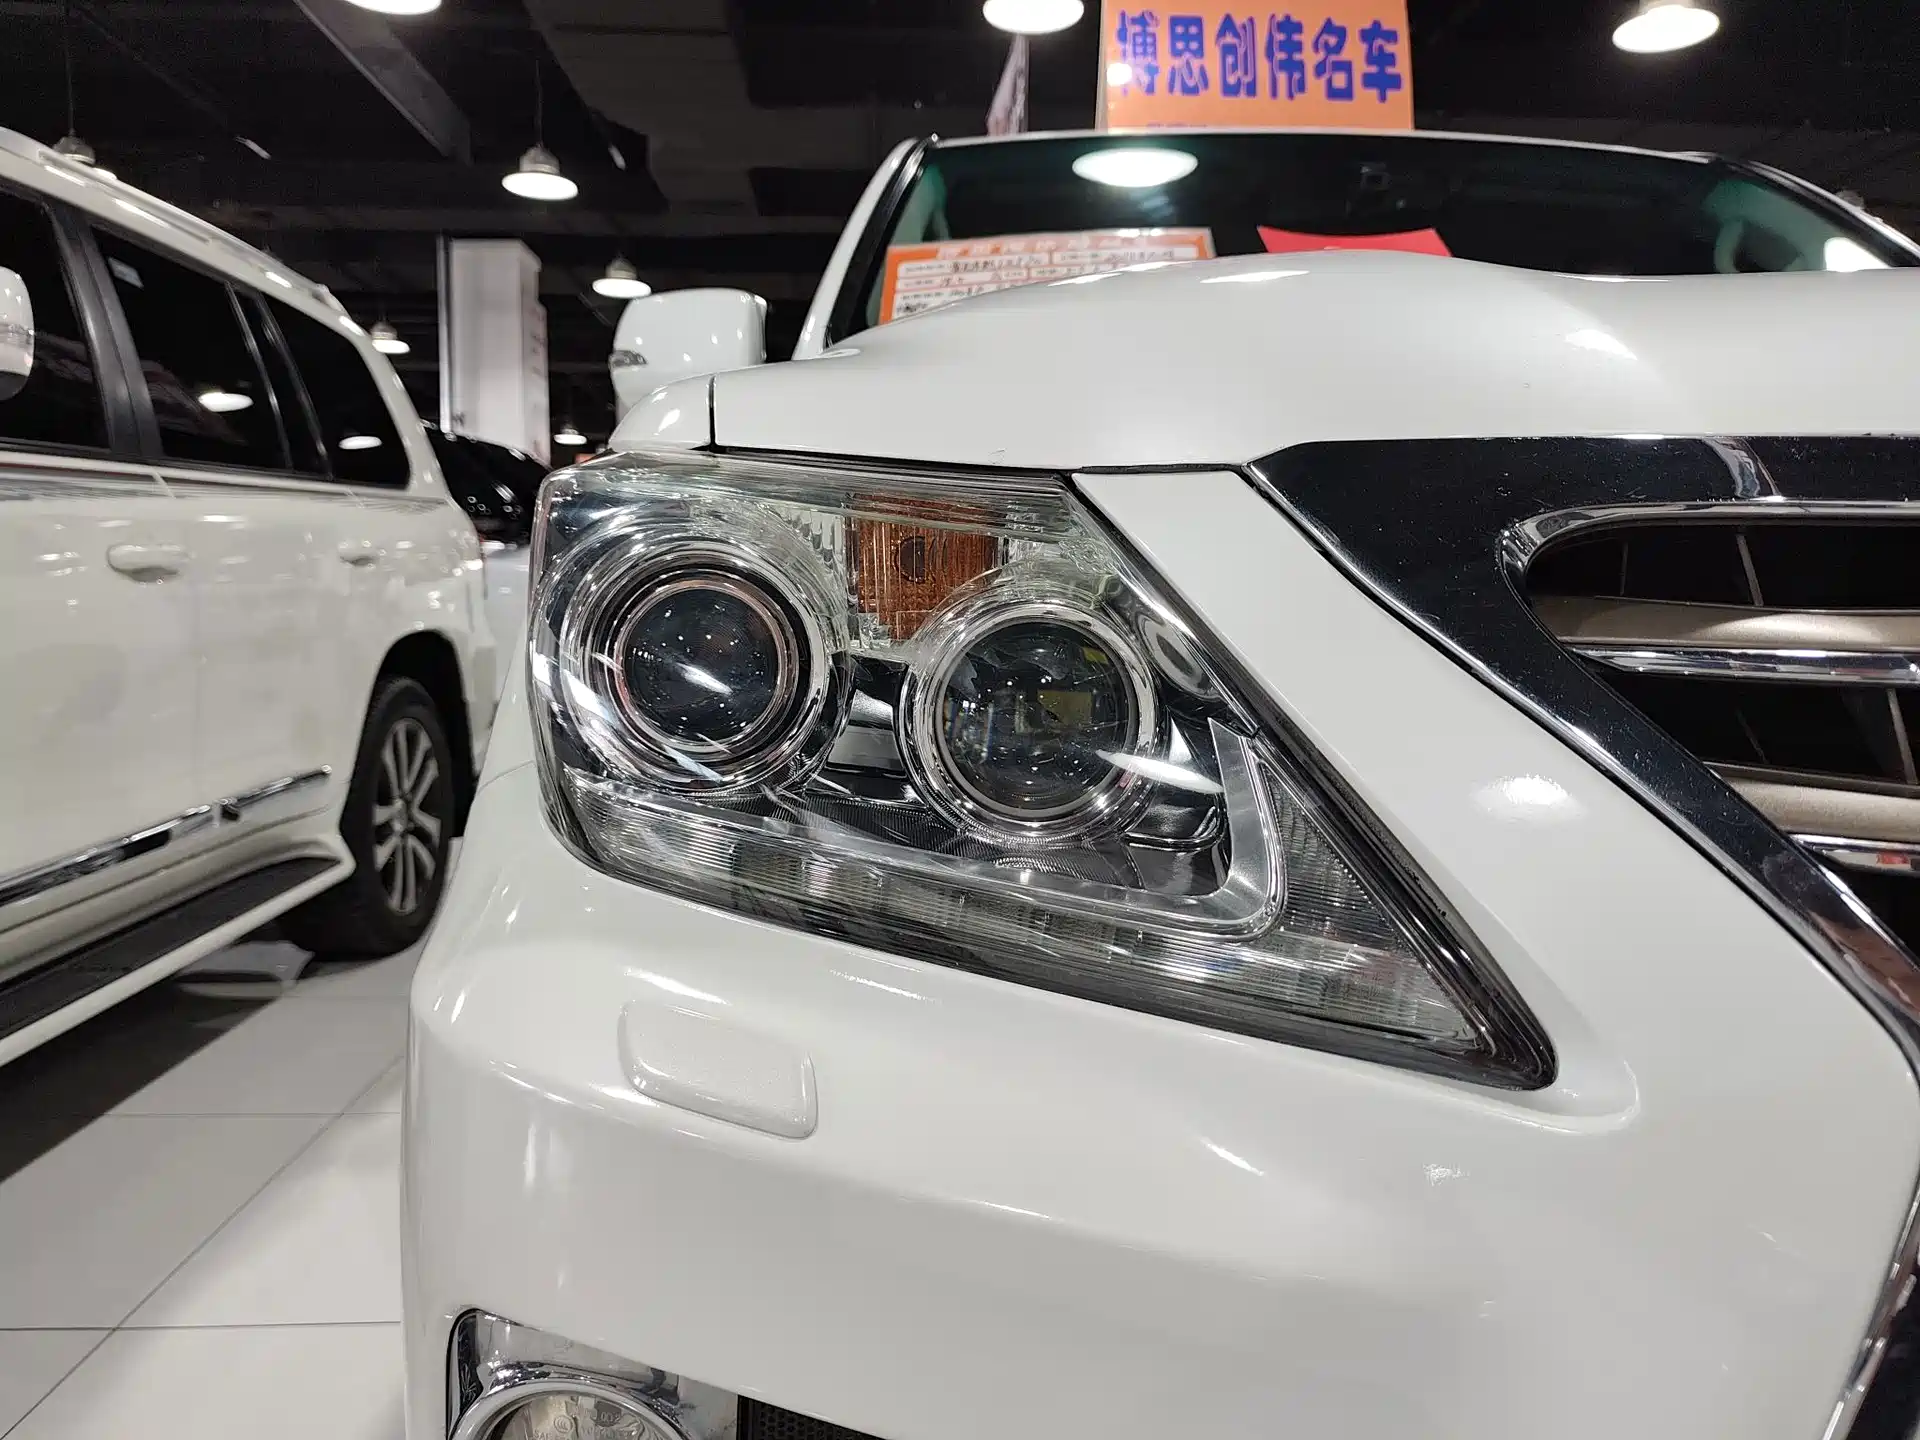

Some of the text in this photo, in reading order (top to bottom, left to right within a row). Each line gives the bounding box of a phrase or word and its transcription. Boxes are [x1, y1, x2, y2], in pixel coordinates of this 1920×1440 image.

[1116, 9, 1402, 104] 博思创伟名车
